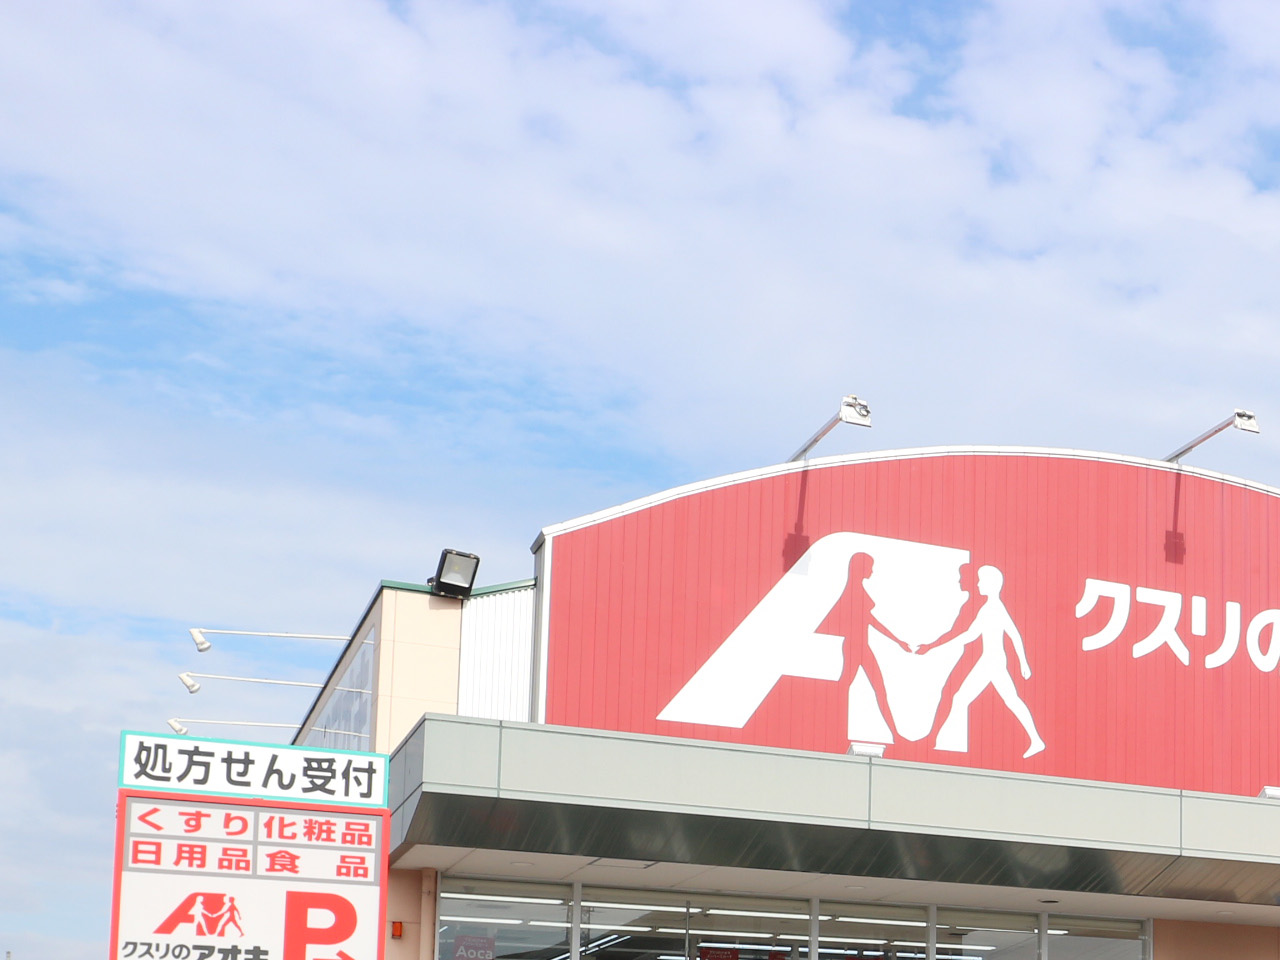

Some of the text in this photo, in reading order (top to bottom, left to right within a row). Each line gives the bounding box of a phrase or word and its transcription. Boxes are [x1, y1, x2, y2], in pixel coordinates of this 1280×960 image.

[134, 741, 377, 799] 処方せん受付
[137, 807, 249, 836] くすり
[263, 815, 373, 846] 化粧品
[131, 840, 251, 871] 日用品
[455, 945, 494, 960] Aoca
